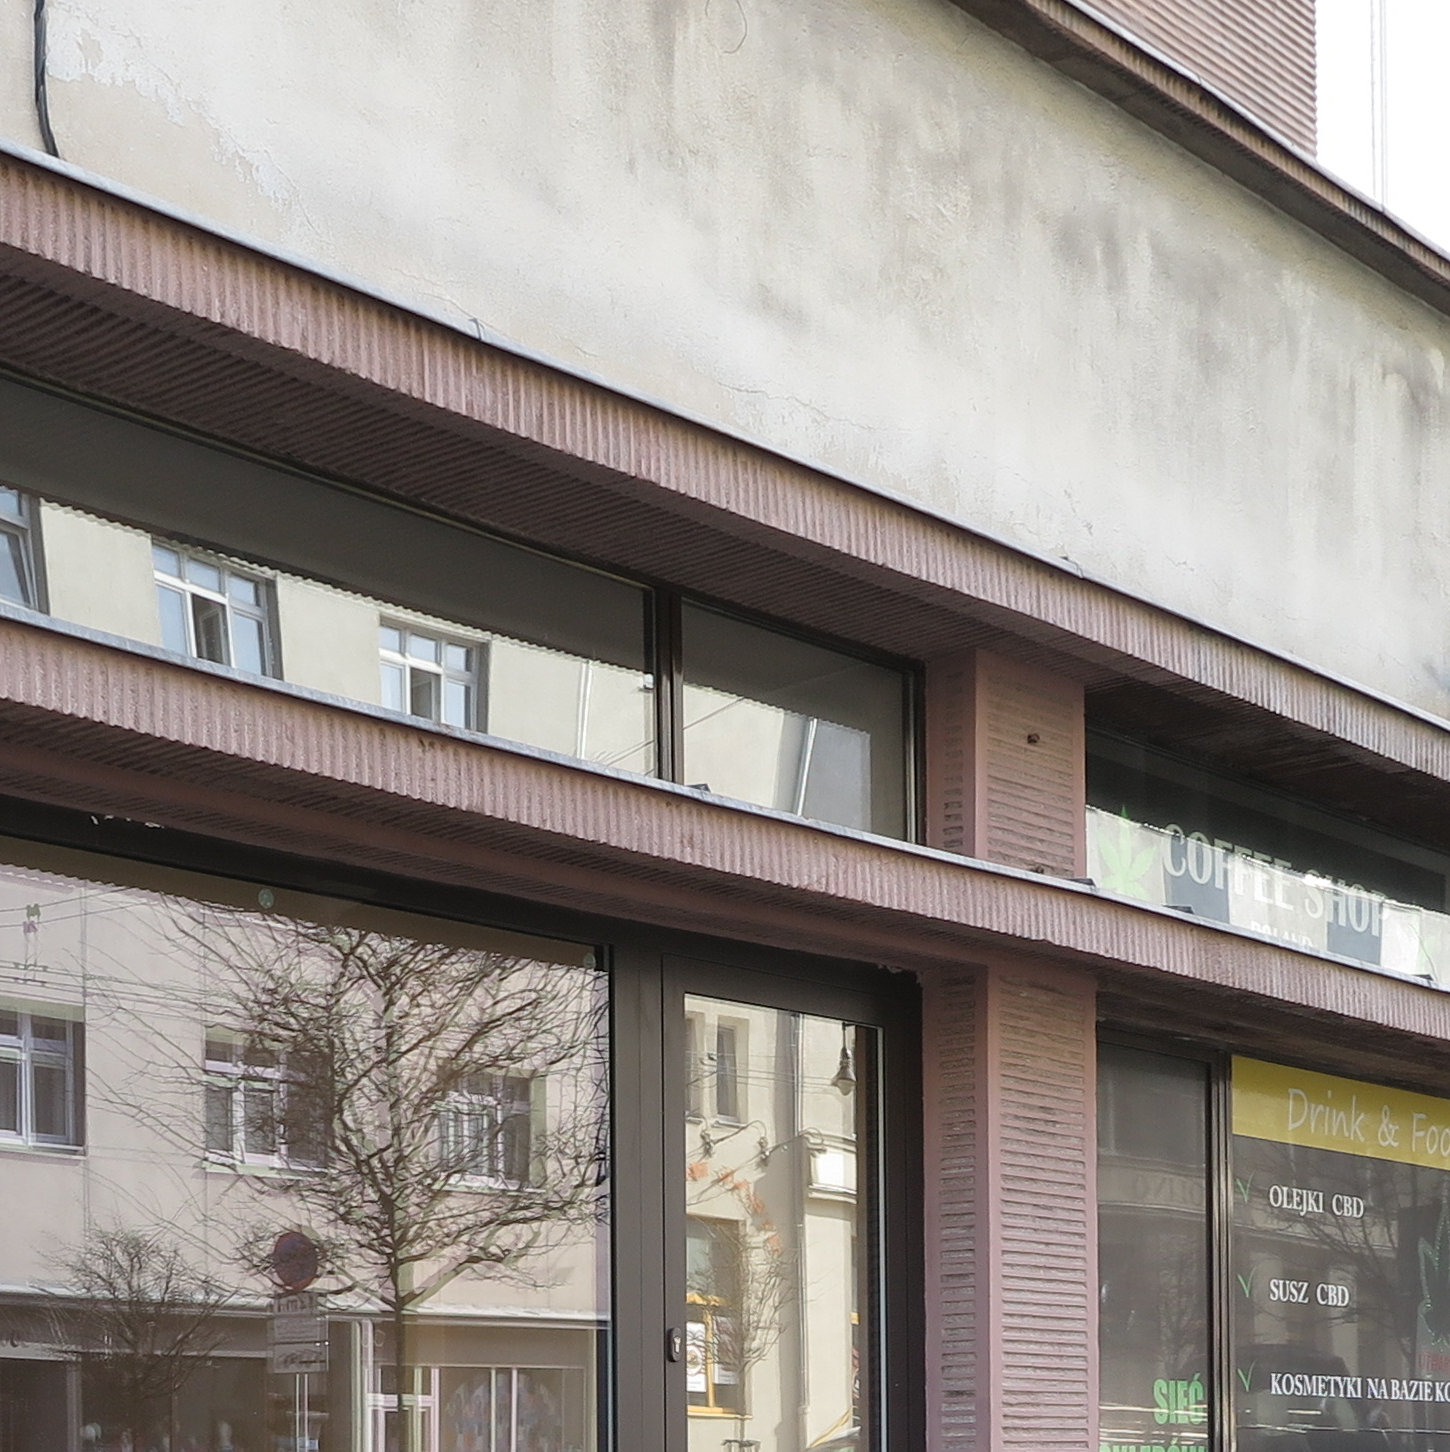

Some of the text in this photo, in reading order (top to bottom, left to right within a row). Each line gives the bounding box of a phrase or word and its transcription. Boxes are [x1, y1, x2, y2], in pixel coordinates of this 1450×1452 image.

[1163, 823, 1389, 937] COFFEE SHOP
[1287, 1088, 1365, 1142] Drink
[1377, 1105, 1399, 1147] &
[1269, 1184, 1365, 1219] OLEJKI CBD
[1269, 1279, 1350, 1308] SUSZ CBD
[1153, 1372, 1205, 1426] SIEĆ
[1270, 1372, 1363, 1399] KOSMETYKI
[1367, 1377, 1389, 1401] NA
[1391, 1379, 1433, 1402] BAZIE
